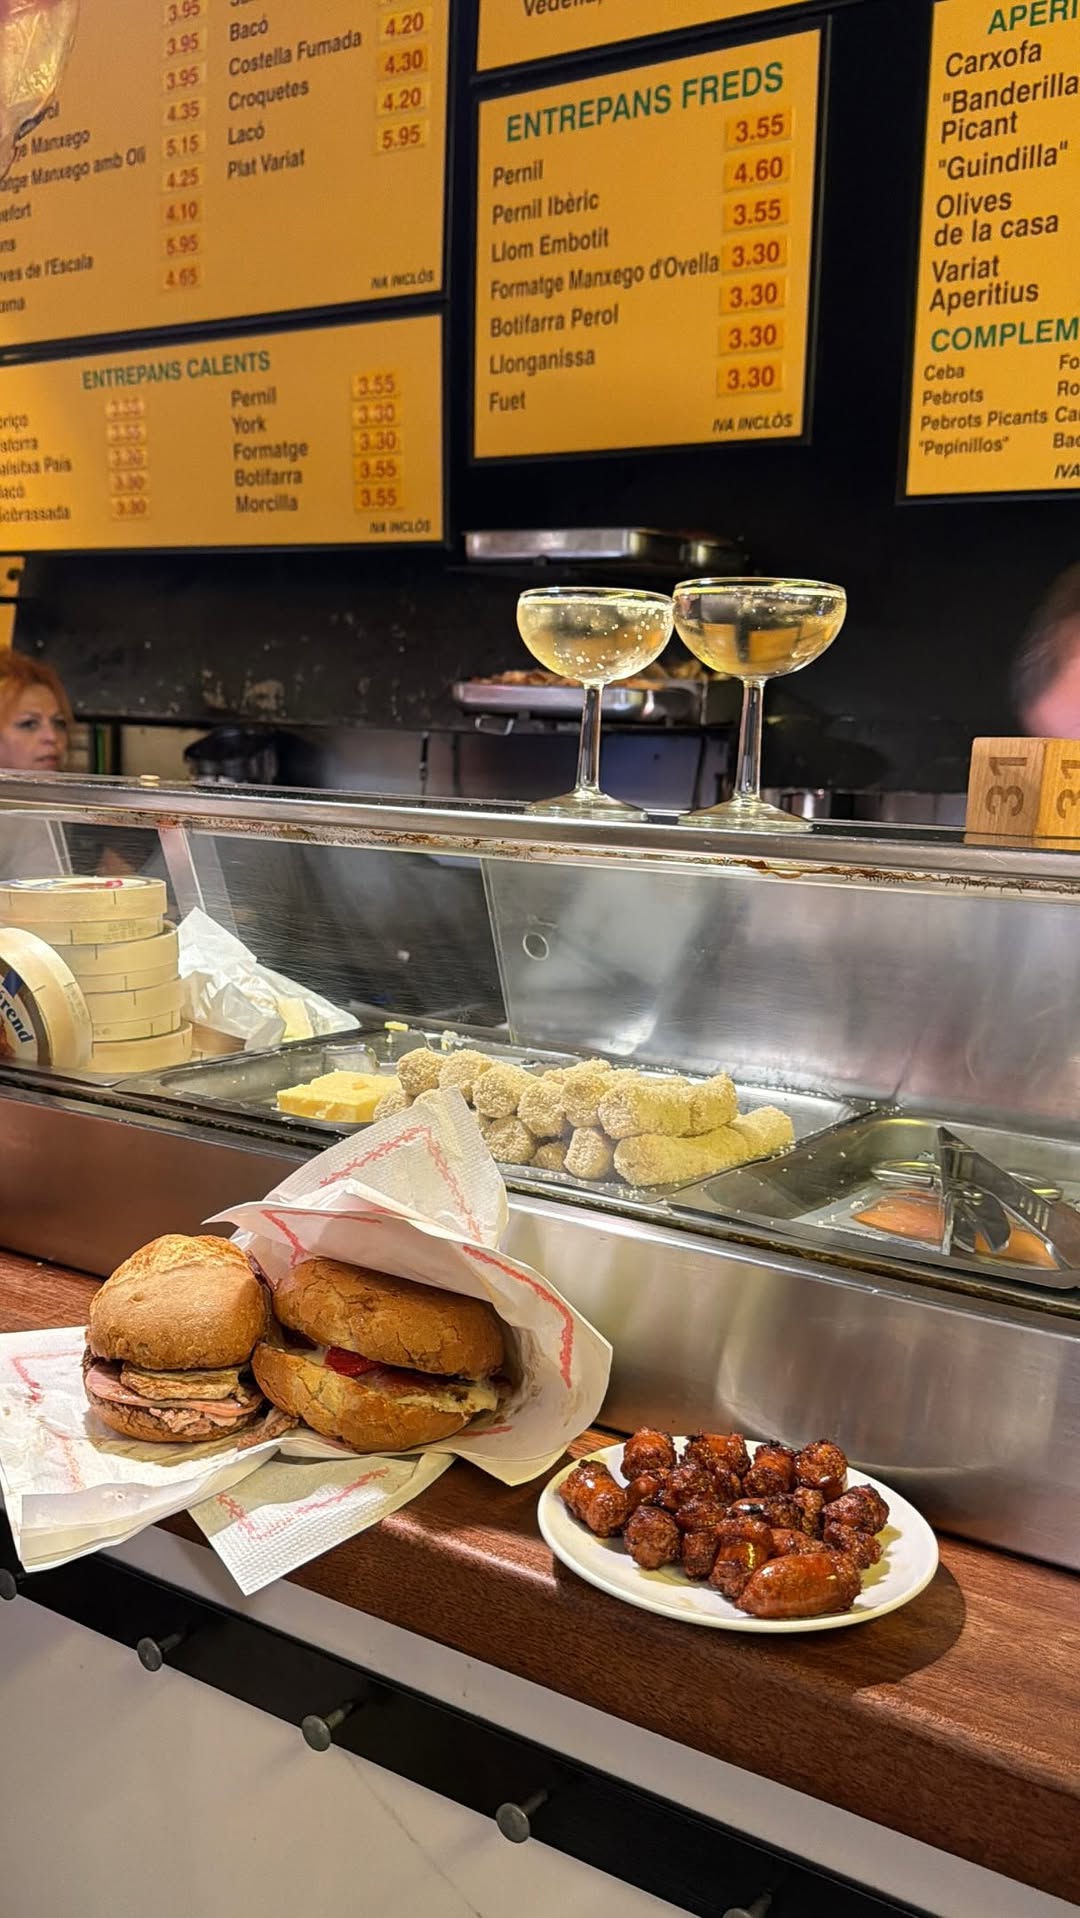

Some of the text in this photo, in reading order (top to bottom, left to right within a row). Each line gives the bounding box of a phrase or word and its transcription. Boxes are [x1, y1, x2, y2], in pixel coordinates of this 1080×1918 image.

[168, 0, 200, 22] 3.95
[229, 14, 269, 42] Bacó
[384, 12, 425, 37] 4.20
[167, 33, 200, 56] 3.95
[229, 29, 363, 76] Costella Fumada
[384, 49, 424, 75] 4.30
[945, 39, 1042, 78] Carxofa
[167, 66, 200, 90] 3.95
[228, 79, 311, 112] Croquetes
[382, 87, 423, 112] 4.20
[506, 61, 784, 143] ENTREPANS FREDS
[942, 72, 1079, 114] "Banderilla
[167, 101, 200, 121] 4.35
[227, 120, 266, 146] Lacó
[382, 124, 422, 150] 5.95
[735, 114, 784, 143] 3.55
[941, 110, 1018, 144] Picant
[31, 129, 91, 155] Manxego
[166, 134, 200, 158] 5.15
[32, 160, 91, 185] Manxego
[93, 152, 124, 174] amb
[126, 147, 147, 167] Oli
[227, 148, 306, 180] Plat Variat
[734, 156, 783, 183] 4.60
[938, 139, 1068, 181] "Guindilla"
[167, 168, 200, 188] 4.25
[492, 160, 544, 188] Pernil
[166, 201, 199, 221] 4.10
[492, 190, 600, 226] Pernil Ibèric
[733, 199, 782, 226] 3.55
[936, 191, 1012, 219] Olives
[934, 214, 1059, 247] de la casa
[166, 234, 199, 256] 5.95
[491, 228, 609, 263] Llom Embotit
[731, 241, 780, 268] 3.30
[25, 261, 41, 279] de
[490, 252, 720, 300] Formatge Manxego d'Ovella
[932, 255, 1000, 284] Variat
[729, 282, 778, 309] 3.30
[929, 281, 1039, 316] Aperitius
[490, 303, 619, 338] Botifarra Perol
[728, 324, 777, 350] 3.30
[930, 317, 1080, 352] COMPLEM
[82, 350, 271, 390] ENTREPANS CALENTS
[489, 347, 596, 377] Llonganissa
[924, 364, 966, 381] Ceba
[358, 374, 396, 395] 3.55
[726, 365, 775, 391] 3.30
[231, 386, 277, 408] Pernil
[488, 391, 526, 413] Fuet
[922, 388, 984, 406] Pebrots
[231, 415, 267, 434] York
[358, 404, 396, 424] 3.30
[712, 416, 733, 433] IVA
[920, 410, 1048, 431] Pebrots Picants
[233, 441, 309, 462] Formatge
[359, 431, 397, 451] 3.30
[919, 436, 1010, 459] "Pepinillos"
[234, 467, 303, 487] Botifarra
[360, 459, 397, 479] 3.55
[235, 494, 299, 513] Morcilla
[360, 487, 397, 507] 3.55
[985, 756, 1028, 818] 31
